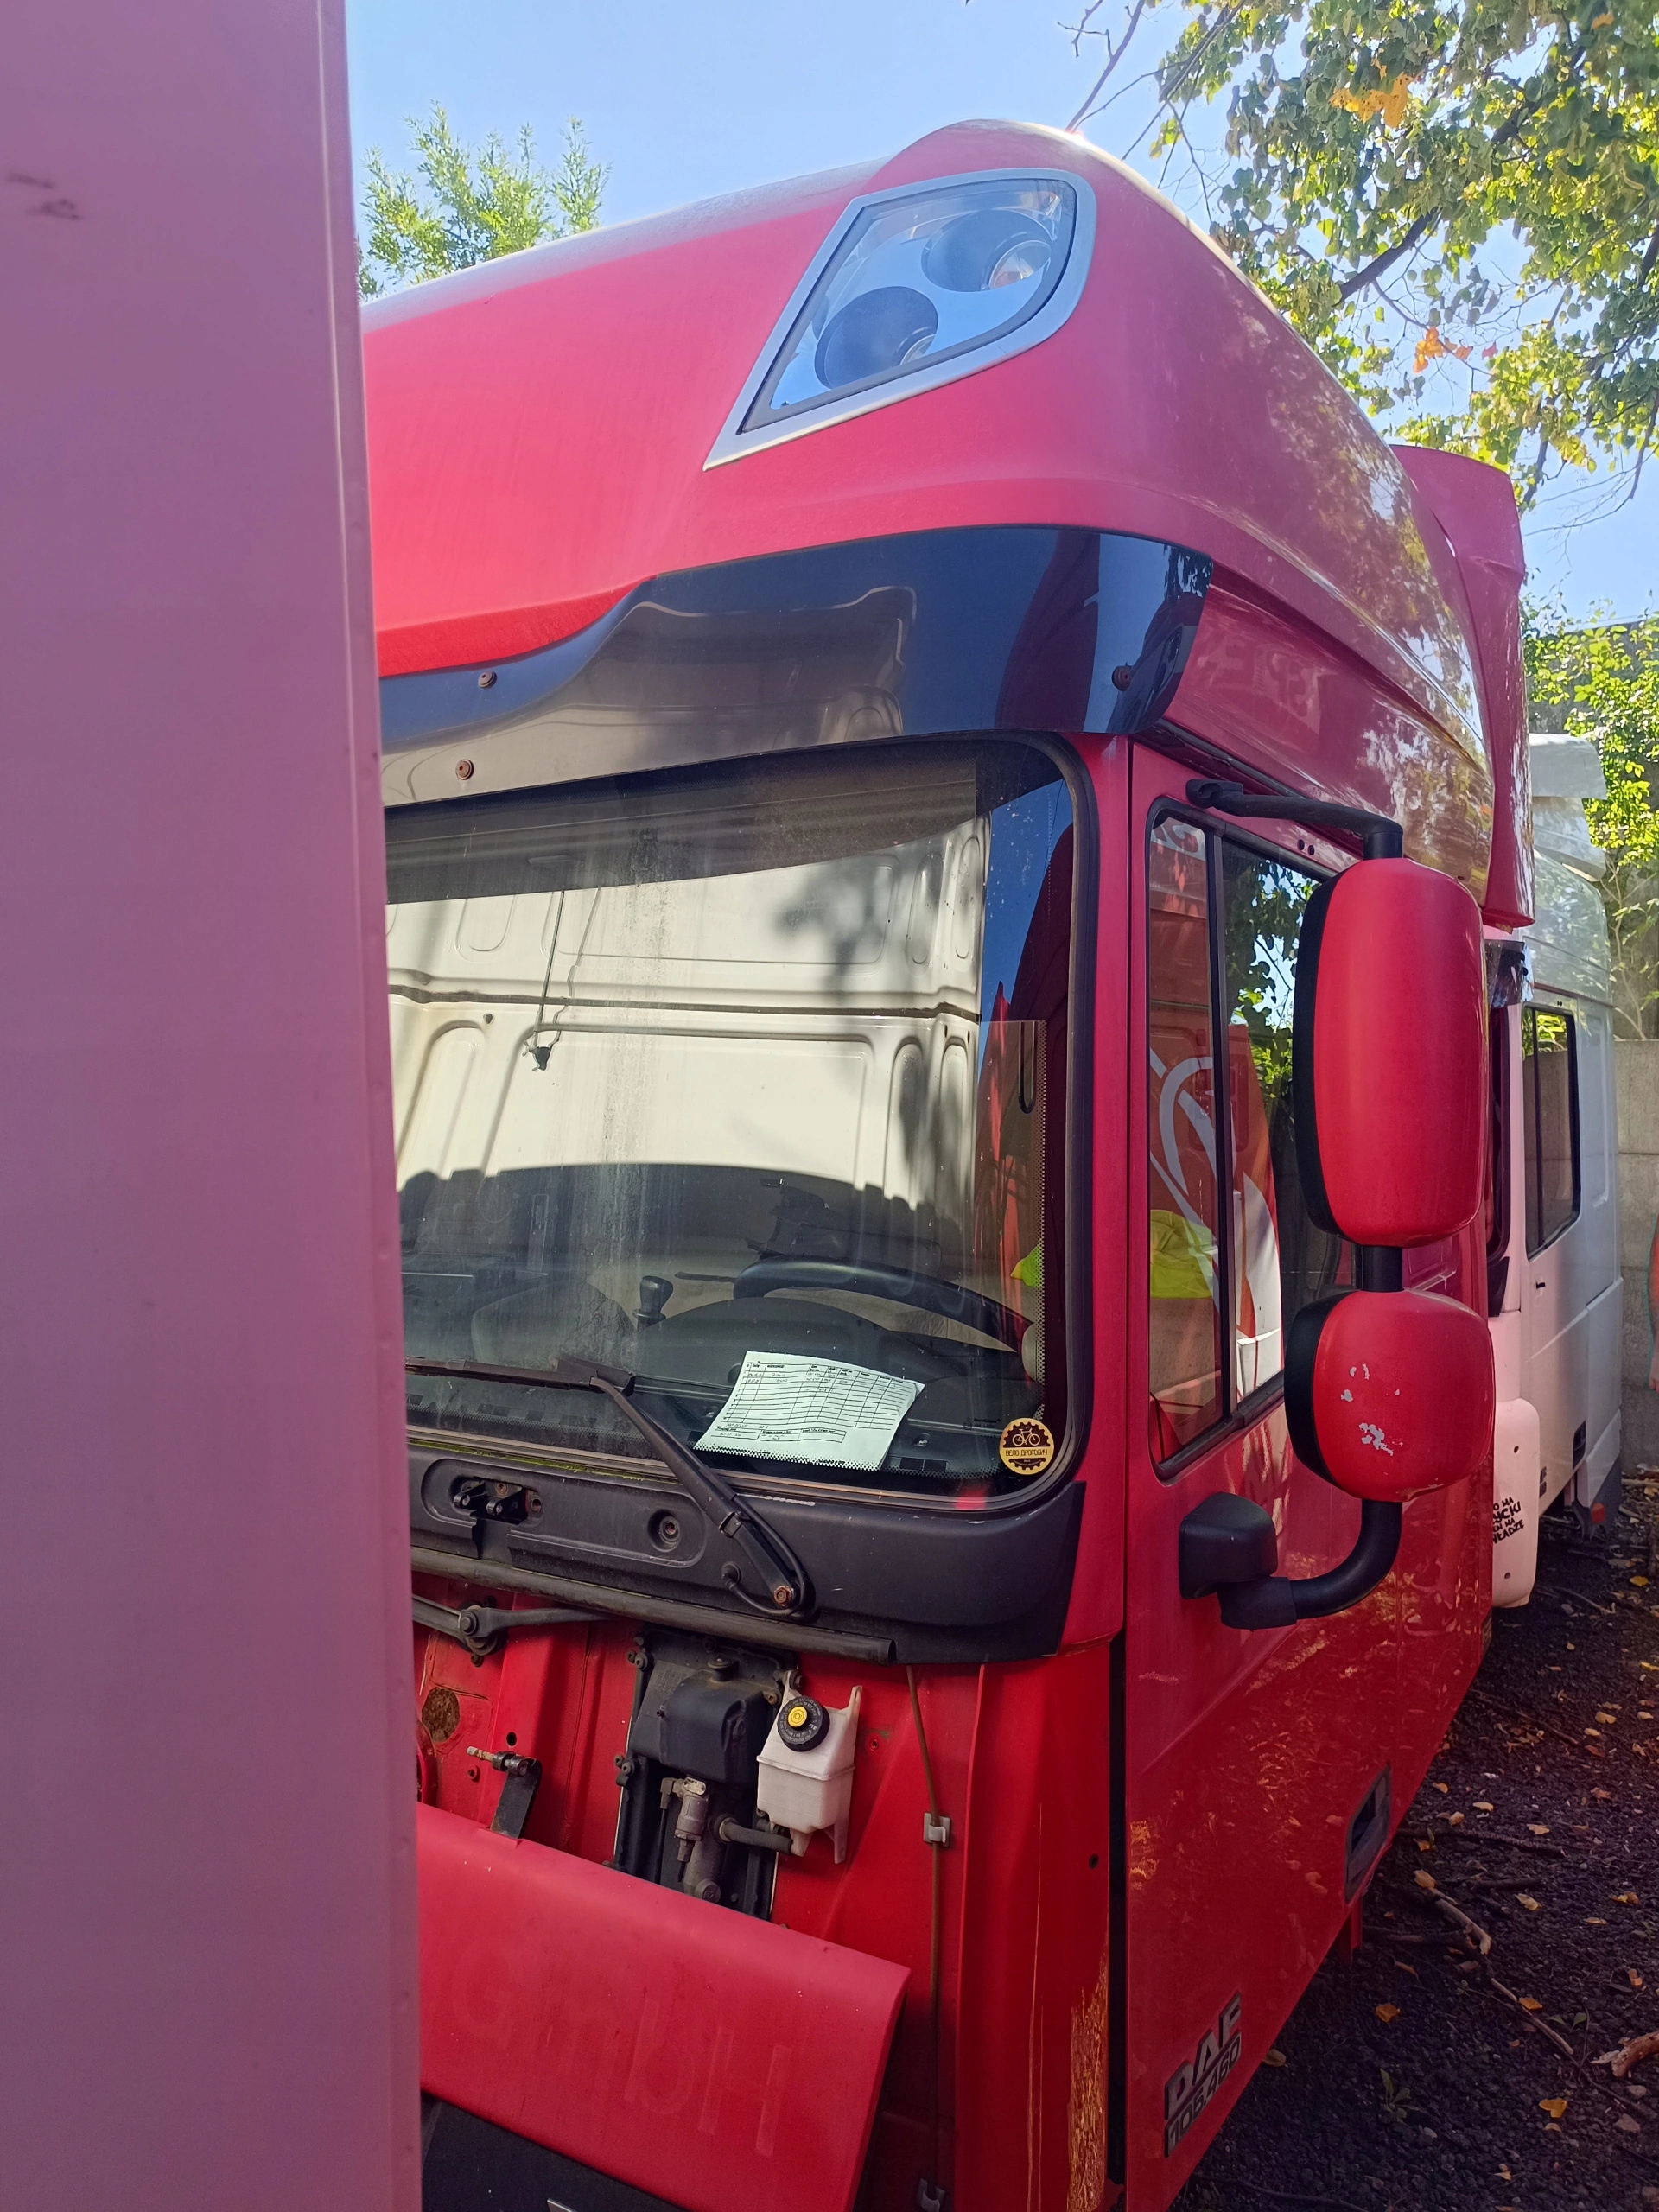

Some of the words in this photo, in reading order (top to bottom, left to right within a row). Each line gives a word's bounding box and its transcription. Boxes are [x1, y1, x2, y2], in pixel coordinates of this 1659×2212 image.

[1493, 1501, 1521, 1523] YCKI
[1493, 1522, 1503, 1532] EN
[1165, 1990, 1242, 2124] DAF
[1169, 2035, 1242, 2152] 105.460
